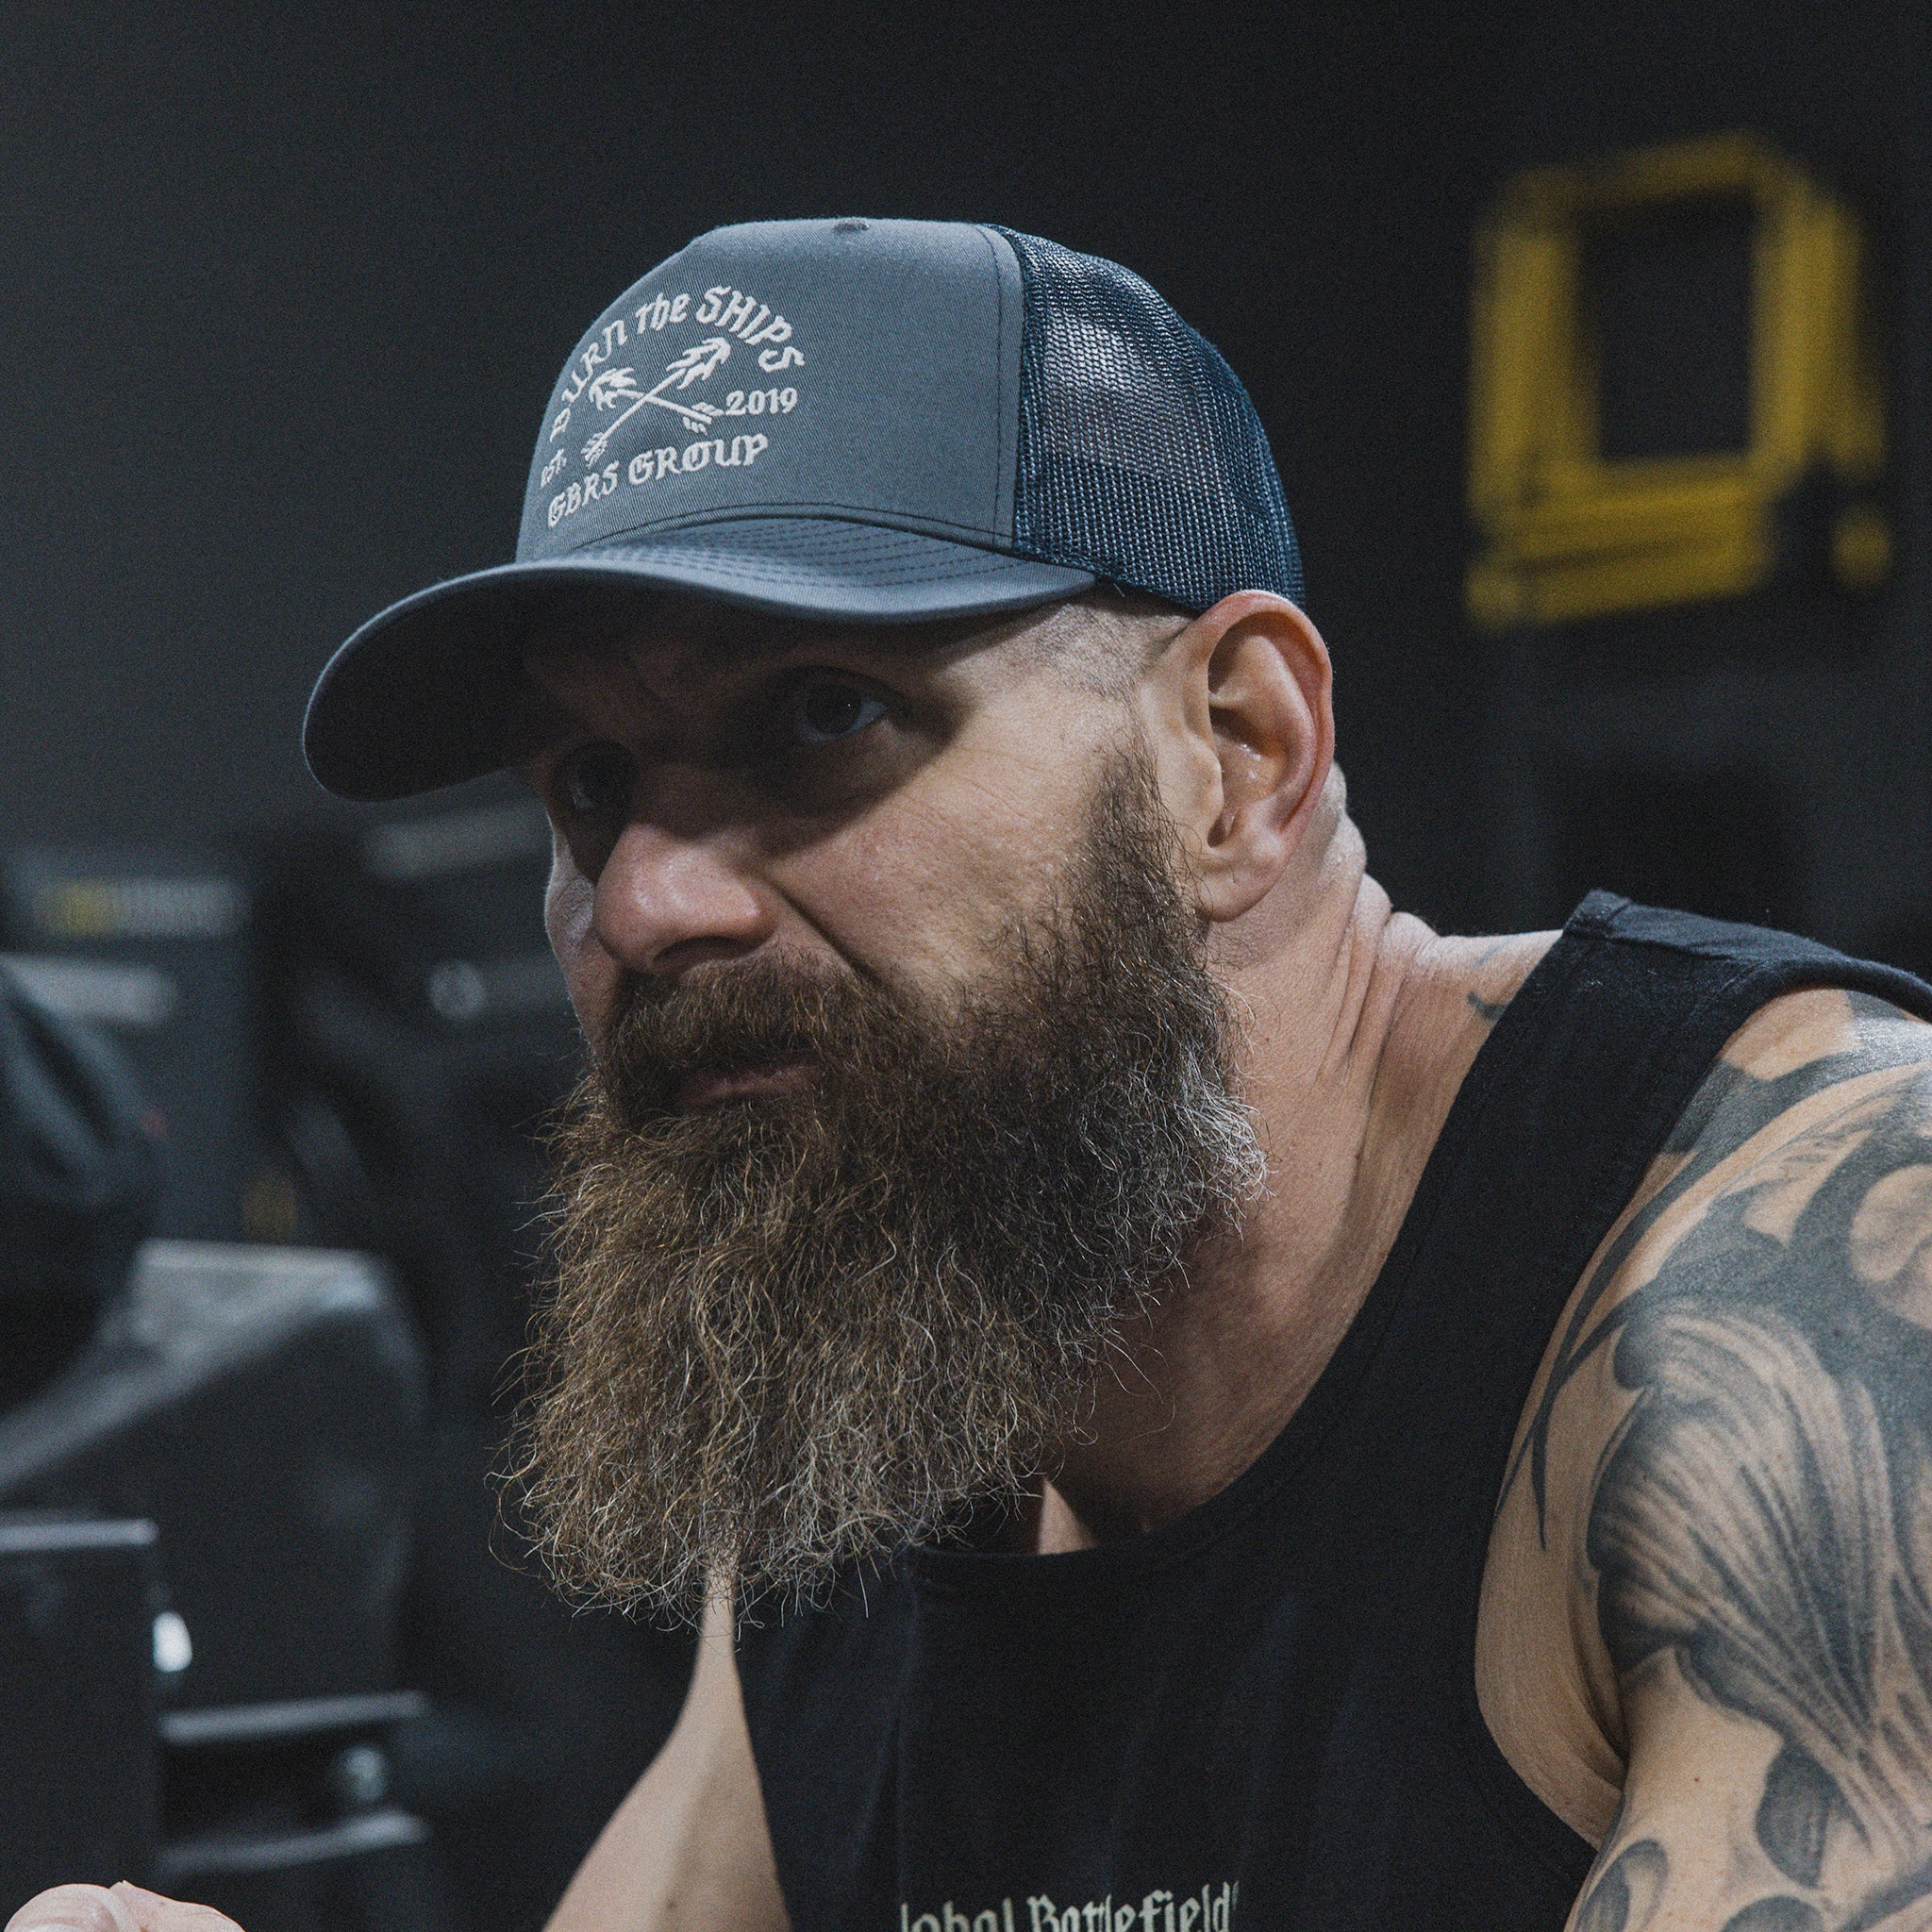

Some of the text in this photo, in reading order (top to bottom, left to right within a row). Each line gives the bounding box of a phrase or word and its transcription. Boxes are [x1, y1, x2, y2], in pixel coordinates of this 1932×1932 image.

[696, 285, 806, 374] SHIPS
[725, 387, 798, 417] 2019
[546, 433, 768, 528] GBRS GROUP
